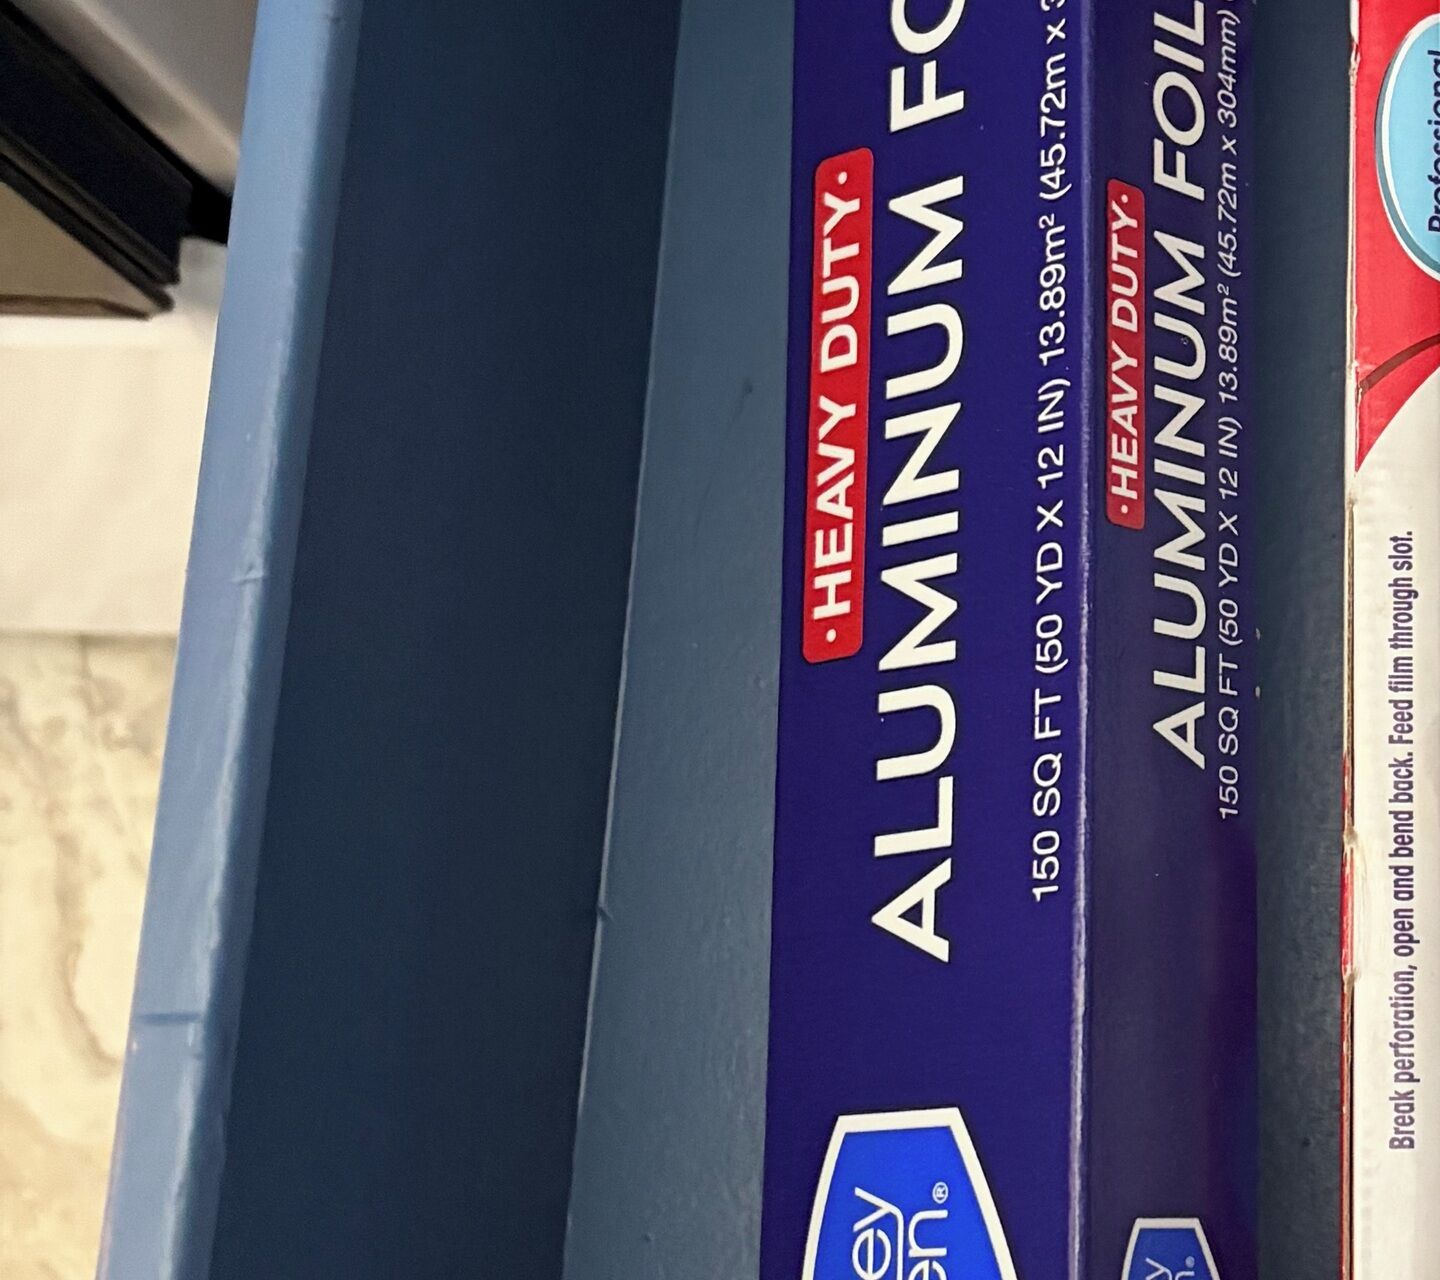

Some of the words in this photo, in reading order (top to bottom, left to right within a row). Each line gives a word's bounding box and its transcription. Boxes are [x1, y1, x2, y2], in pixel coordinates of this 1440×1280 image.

[1045, 19, 1066, 44] x
[1216, 10, 1240, 128] 304mm)
[1039, 53, 1072, 201] (45.72m
[1153, 0, 1206, 201] FOIL
[1221, 135, 1237, 156] x
[1217, 162, 1241, 277] (45.72m
[820, 192, 861, 372] DUTY
[1039, 214, 1067, 366] 13.89m²
[1112, 201, 1138, 333] DUTY
[1216, 284, 1239, 403] 13.89m²
[1037, 378, 1071, 433] IN)
[1111, 341, 1138, 501] HEAVY
[1218, 416, 1242, 459] IN)
[1037, 445, 1063, 488] 12
[1218, 467, 1238, 499] 12
[813, 394, 857, 621] HEAVY
[1038, 500, 1064, 532] X
[1153, 230, 1206, 770] ALUMINUM
[1219, 507, 1239, 536] X
[870, 175, 964, 963] ALUMINUM
[1036, 542, 1064, 604] YD
[1219, 543, 1239, 587] YD
[1388, 530, 1414, 571] slot.
[1218, 599, 1243, 646] (50
[1388, 576, 1419, 650] through
[1035, 614, 1069, 674] (50
[1219, 653, 1239, 696] FT
[1388, 656, 1414, 694] film
[1034, 688, 1062, 740] FT
[1218, 706, 1240, 756] SQ
[1388, 699, 1415, 745] Feed
[1034, 752, 1063, 817] SQ
[1219, 765, 1239, 820] 150
[1388, 751, 1414, 804] back.
[1388, 810, 1415, 858] bend
[1032, 830, 1060, 902] 150
[1388, 865, 1415, 902] and
[1393, 908, 1420, 958] open
[1388, 965, 1420, 1084] perforation,
[1388, 1089, 1416, 1151] Break
